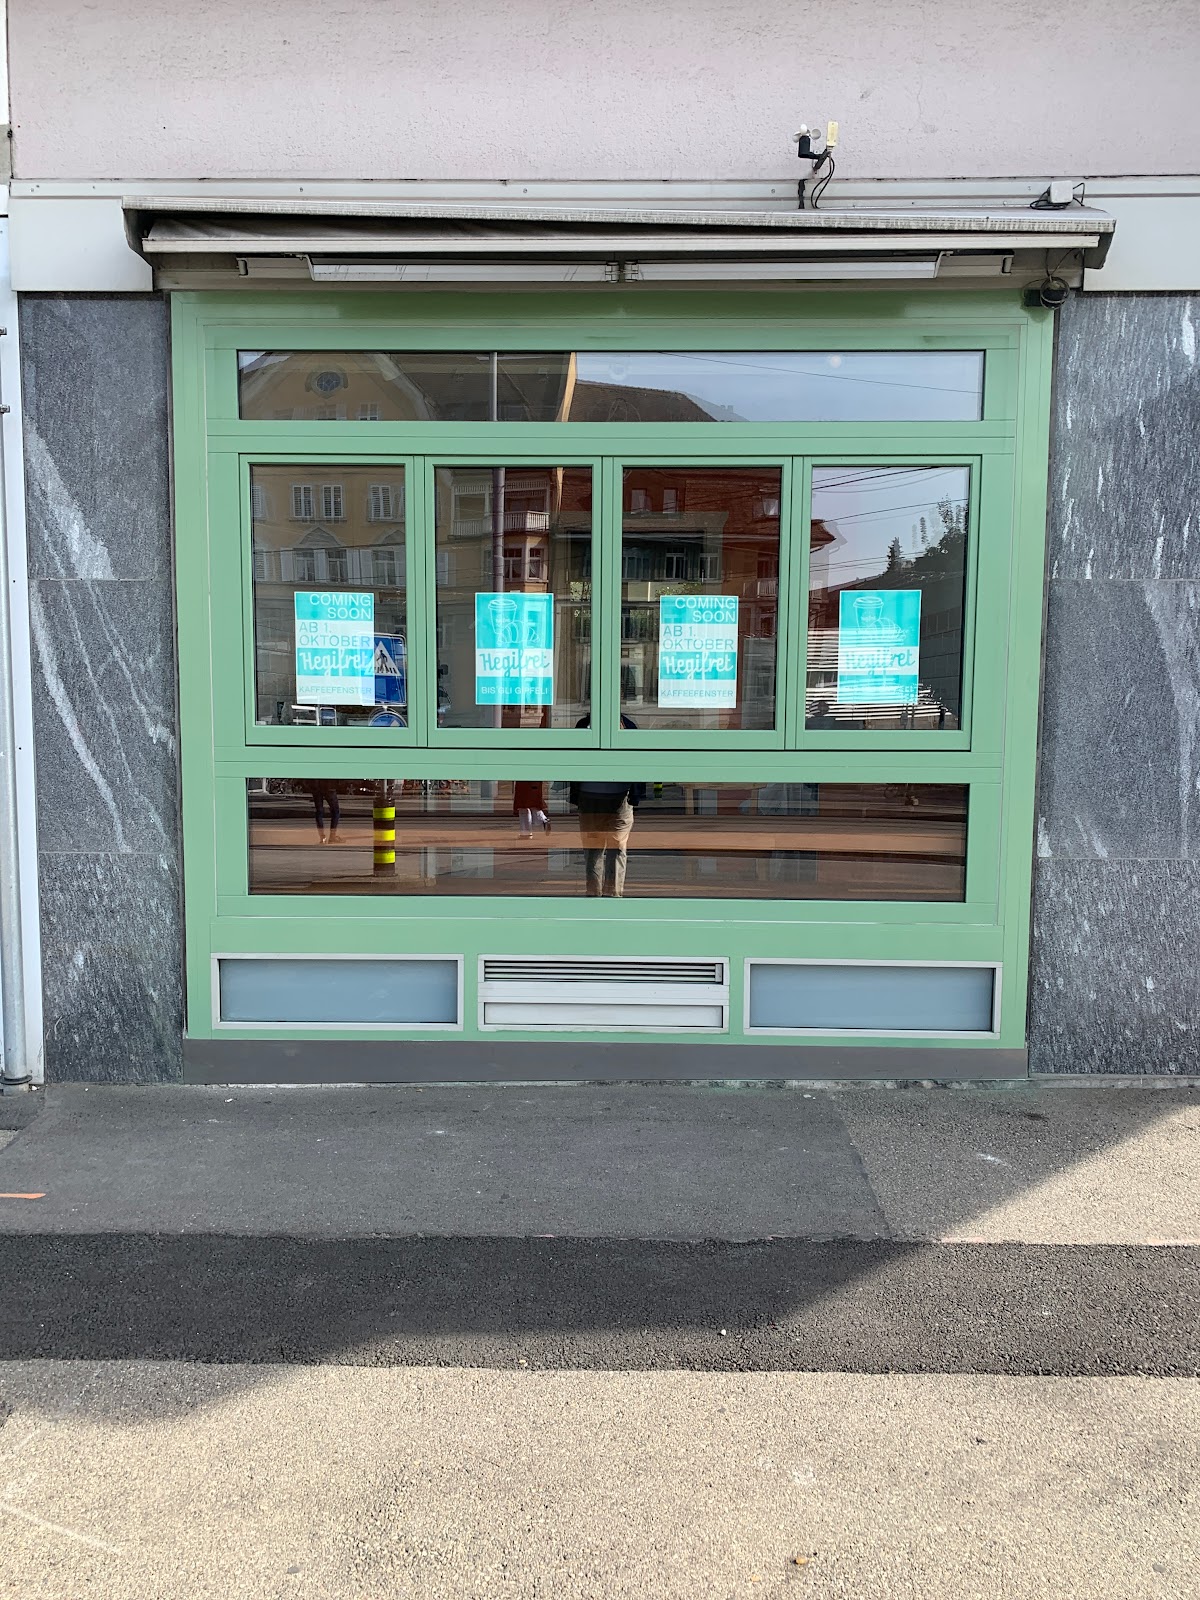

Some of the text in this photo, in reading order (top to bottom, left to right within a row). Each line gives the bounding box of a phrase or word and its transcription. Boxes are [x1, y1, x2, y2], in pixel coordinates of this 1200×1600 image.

[309, 594, 371, 606] COMING
[675, 597, 736, 609] COMING
[328, 607, 371, 619] SOON
[692, 610, 735, 622] SOON
[299, 622, 318, 633] AB
[663, 625, 683, 637] AB
[300, 634, 371, 647] OKTOBER
[663, 638, 734, 650] OKTOBER
[299, 686, 372, 694] KAFFEEFENSTER
[481, 686, 496, 694] BIS
[660, 689, 734, 697] KAFFEEFENSTER
